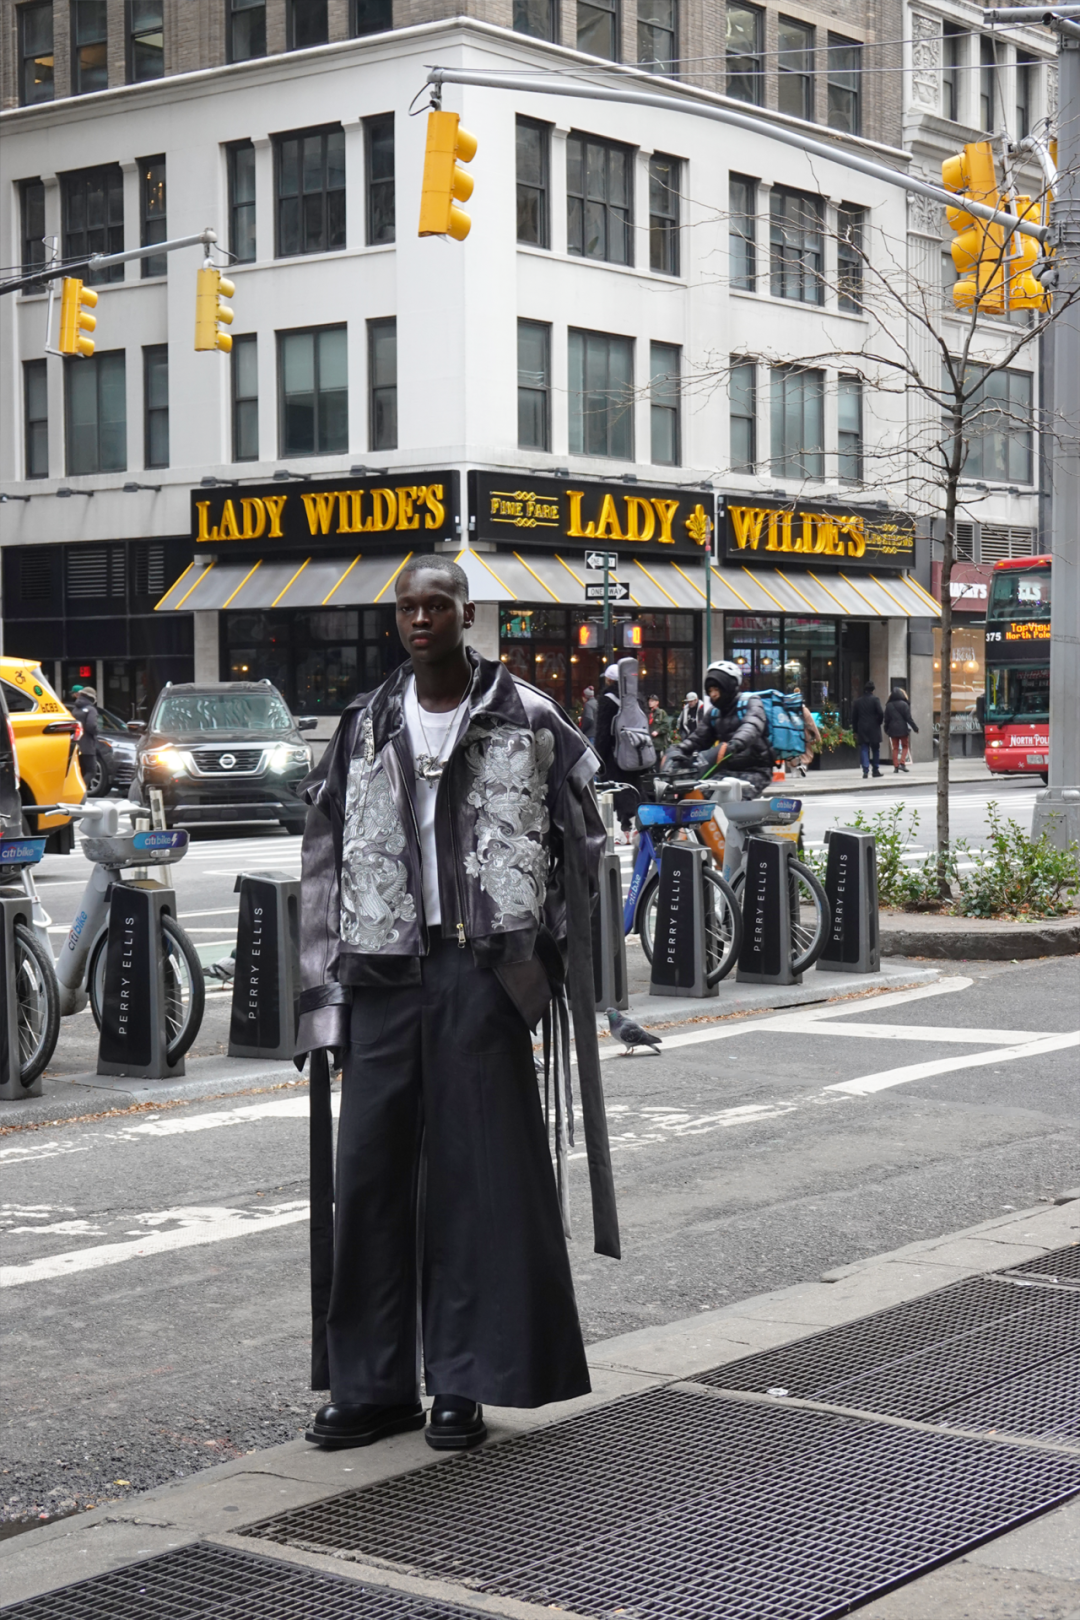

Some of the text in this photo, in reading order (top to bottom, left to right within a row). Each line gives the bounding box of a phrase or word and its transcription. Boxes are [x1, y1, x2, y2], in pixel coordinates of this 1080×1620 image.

[196, 484, 446, 542] LADY WILDE'S
[491, 498, 560, 520] FINE FARE
[566, 490, 680, 544] LADY
[727, 506, 867, 558] WILDE'S
[591, 587, 623, 596] ONE WAY
[986, 632, 1002, 642] 375
[1034, 734, 1049, 746] POL
[74, 911, 88, 935] bike
[668, 871, 681, 963] PERRY ELLIS
[754, 863, 768, 951] PERRY ELLIS
[834, 855, 848, 941] PERRY ELLIS
[119, 917, 134, 1035] PERRY ELLIS
[249, 908, 262, 1018] PERRY ELLIS
